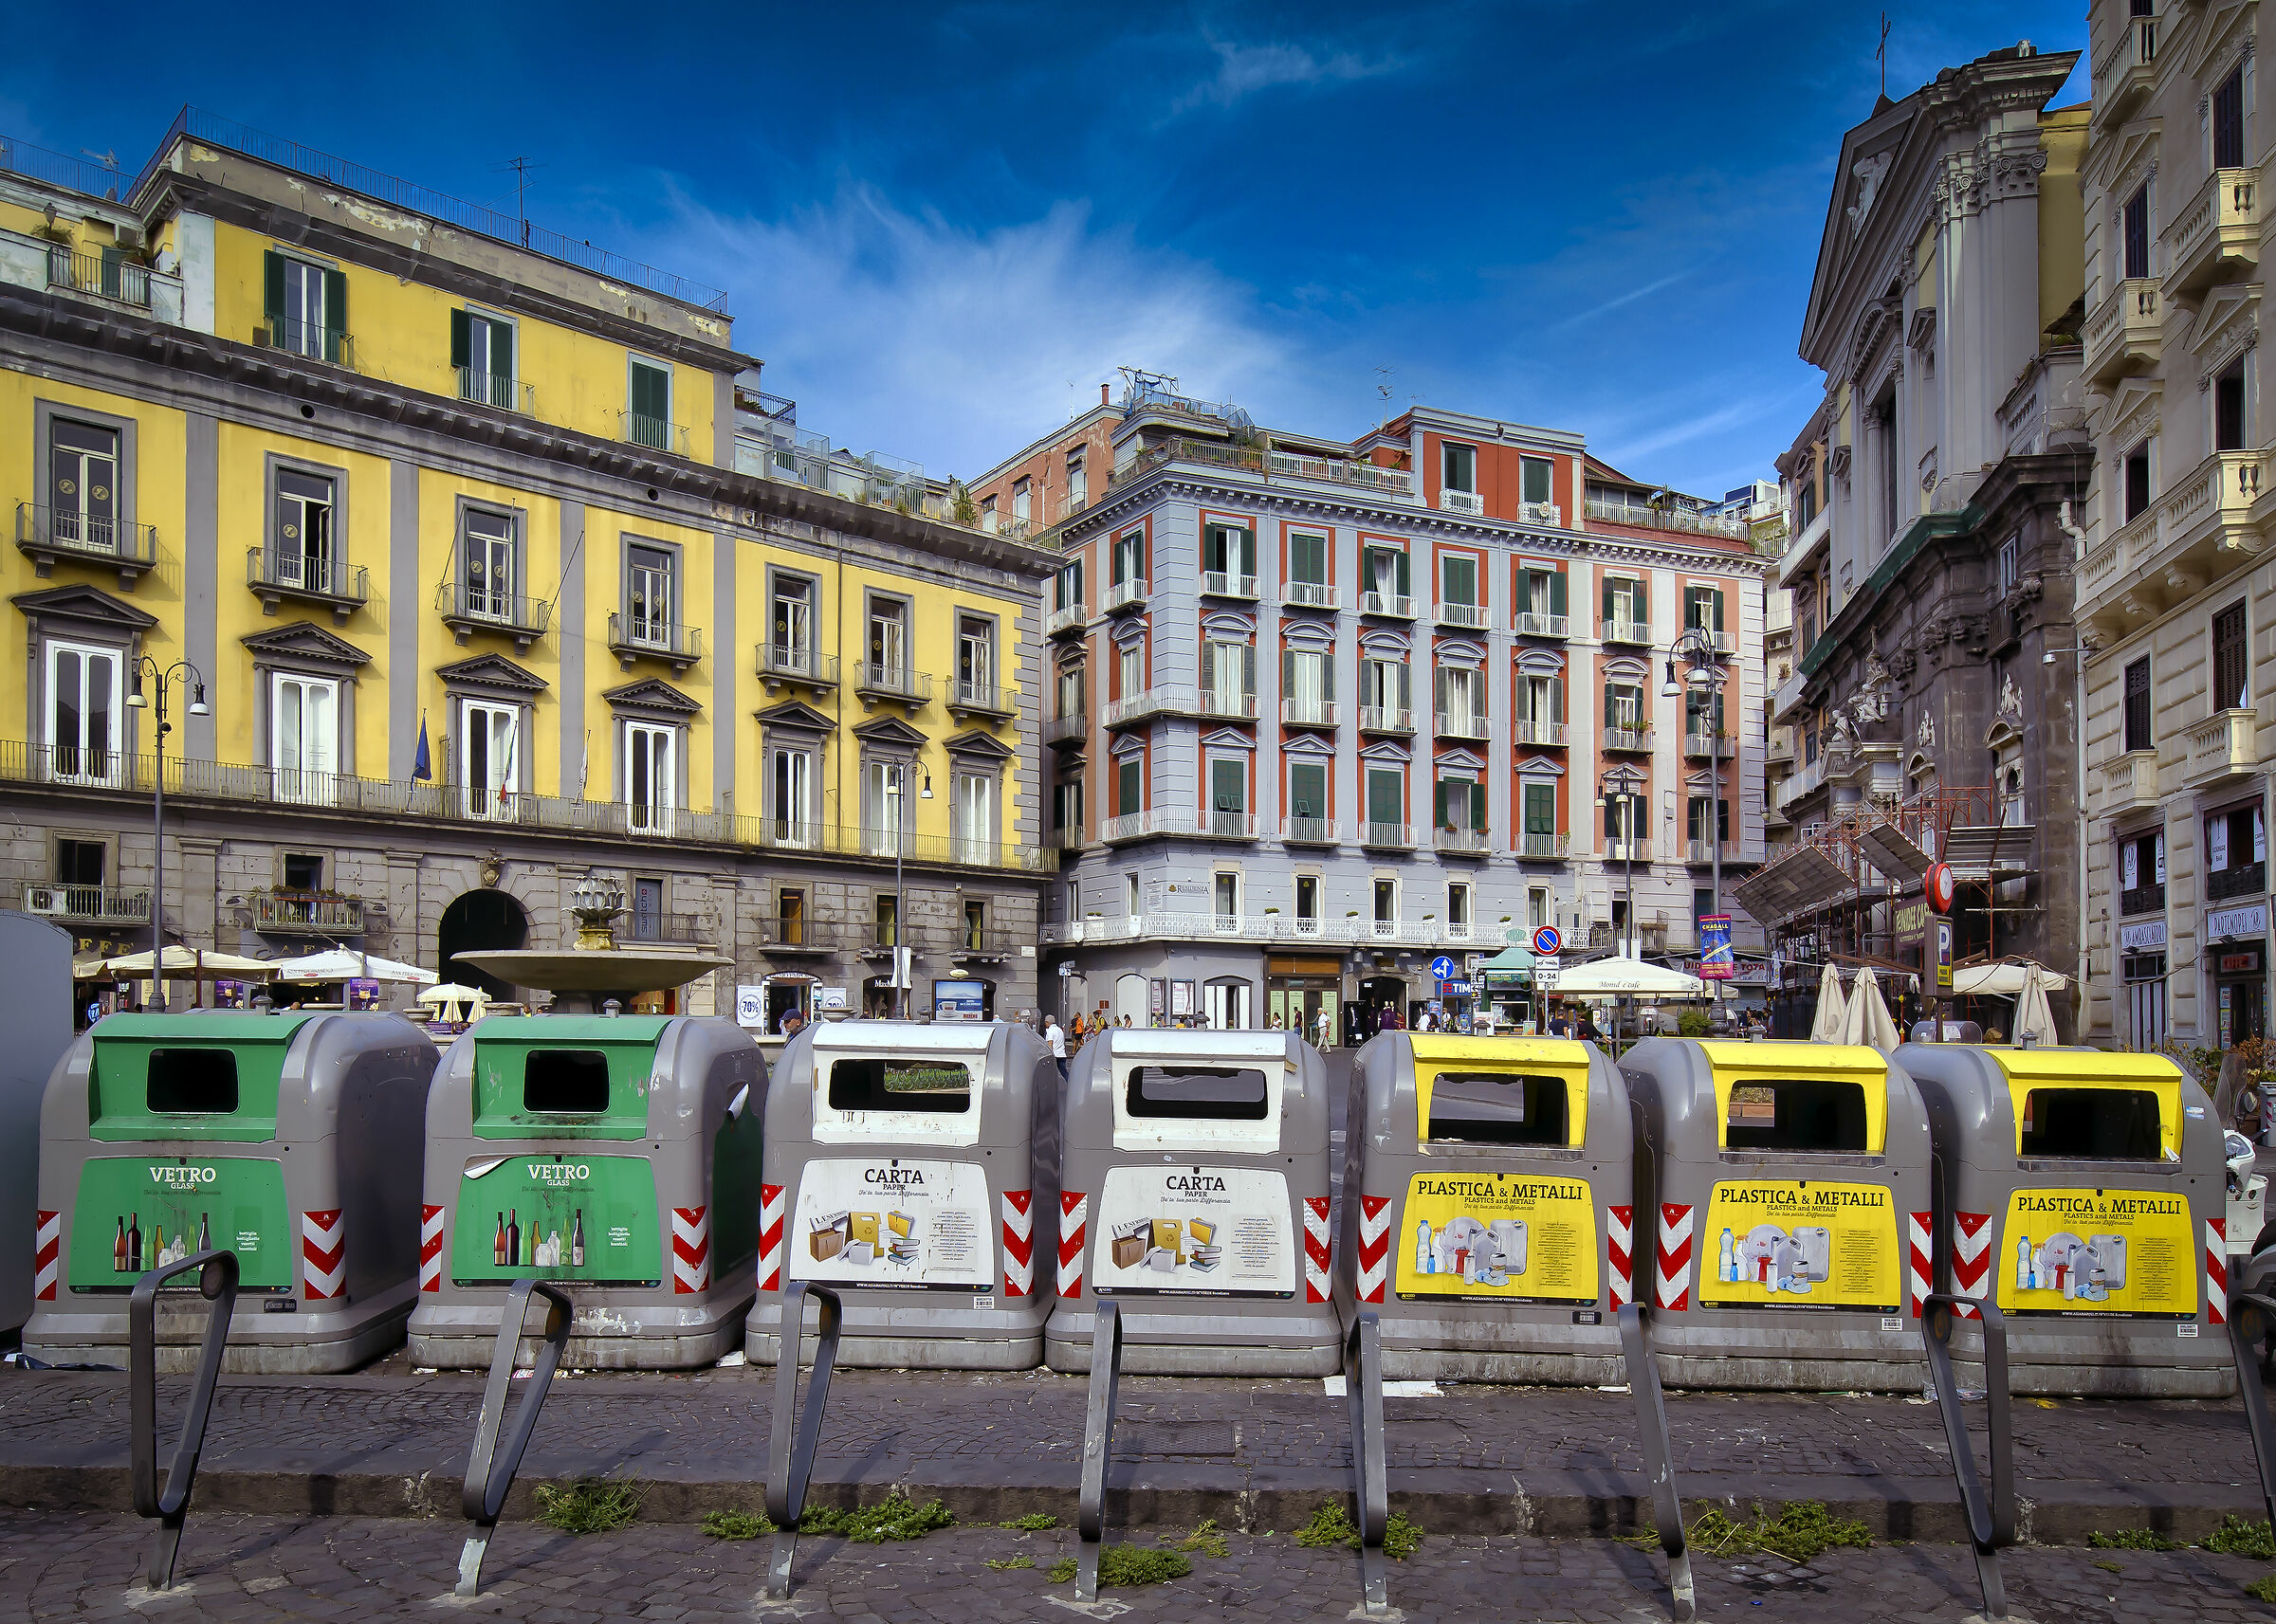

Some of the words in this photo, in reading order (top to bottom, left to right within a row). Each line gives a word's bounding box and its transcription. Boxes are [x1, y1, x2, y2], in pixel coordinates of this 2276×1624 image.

[1177, 885, 1209, 894] RESIDENZA
[1452, 983, 1471, 993] TIM
[149, 1167, 216, 1182] VETRO
[527, 1164, 590, 1179] VETRO
[864, 1168, 925, 1184] CARTA
[1166, 1176, 1226, 1191] CARTA
[1417, 1180, 1495, 1197] PLASTICA
[1499, 1188, 1509, 1197] &
[1513, 1183, 1583, 1200] METALLI
[1719, 1189, 1797, 1204] PLASTICA
[1801, 1195, 1810, 1205] &
[1814, 1191, 1884, 1207] METALLI
[2017, 1197, 2094, 1213] PLASTICA
[2098, 1202, 2107, 1213] &
[2111, 1199, 2181, 1214] METALLI
